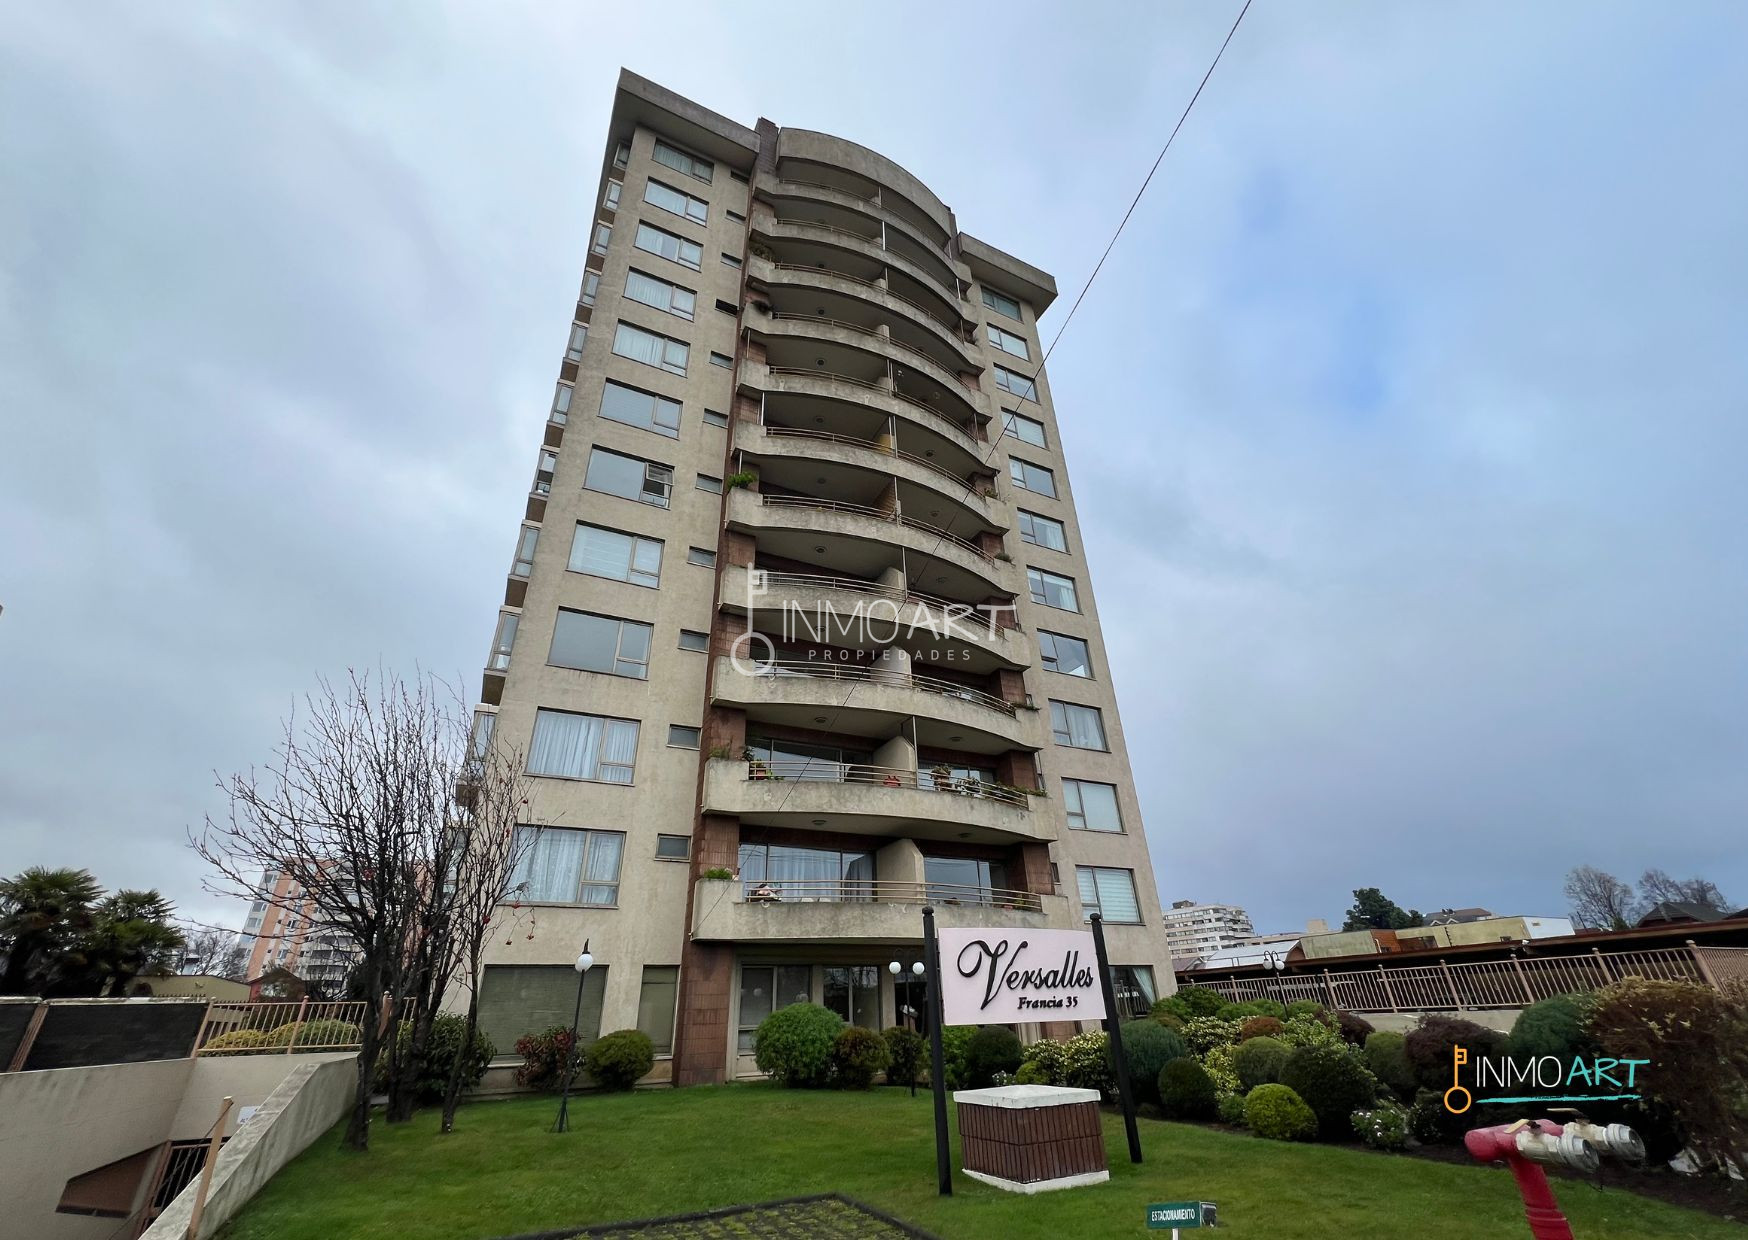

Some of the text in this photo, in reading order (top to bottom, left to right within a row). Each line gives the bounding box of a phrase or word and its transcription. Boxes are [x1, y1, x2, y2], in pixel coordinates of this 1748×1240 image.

[957, 940, 1093, 1010] Versalles
[1017, 996, 1078, 1010] Francia 35
[1151, 1208, 1195, 1222] ESTACIONAMIENTO
